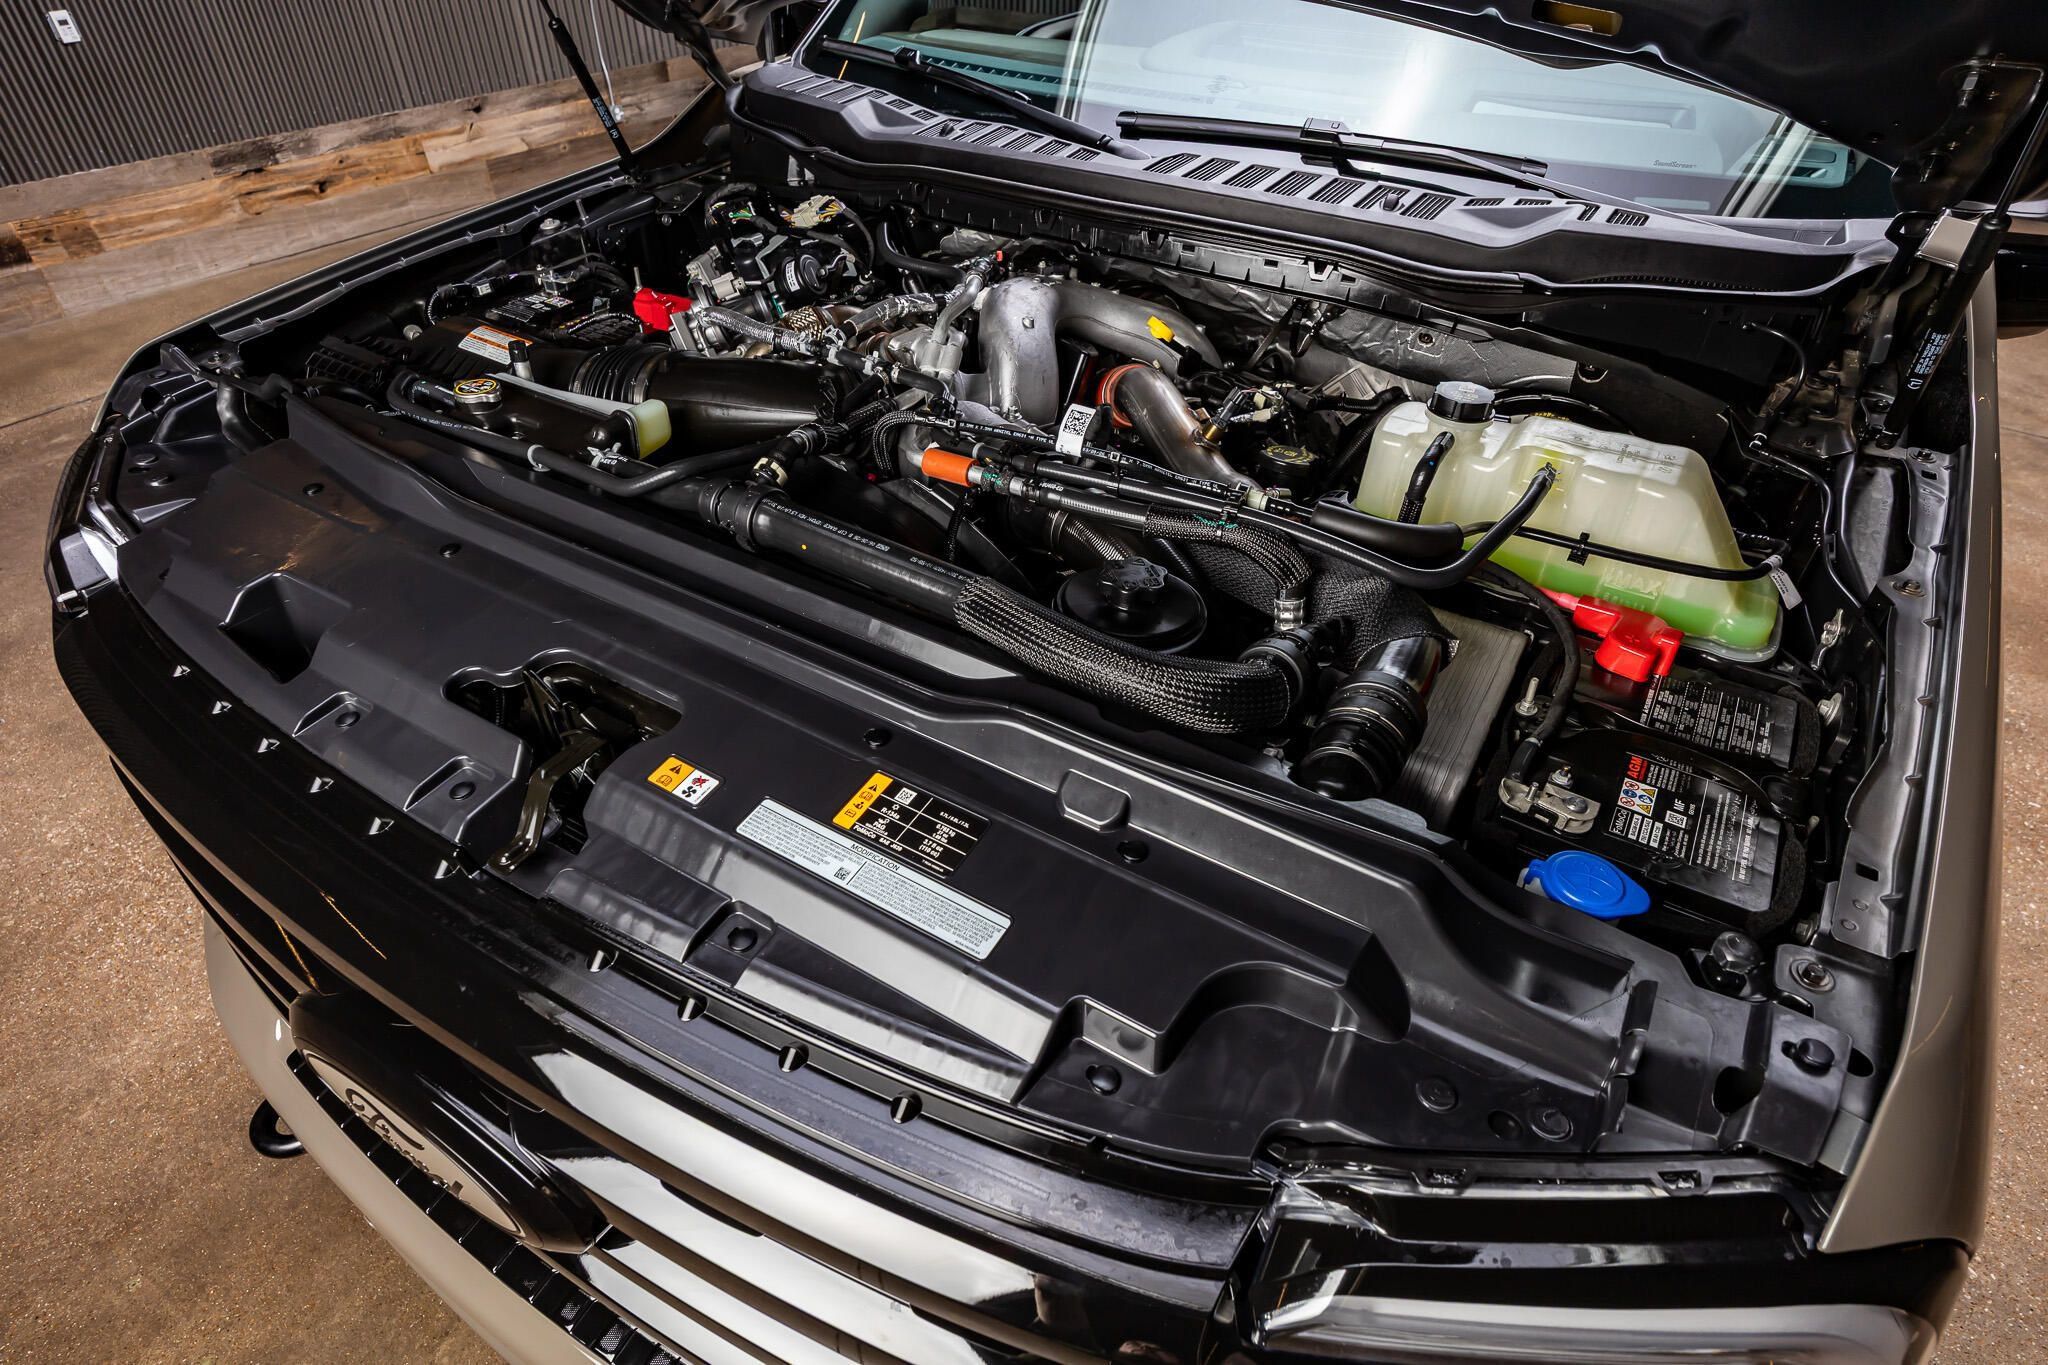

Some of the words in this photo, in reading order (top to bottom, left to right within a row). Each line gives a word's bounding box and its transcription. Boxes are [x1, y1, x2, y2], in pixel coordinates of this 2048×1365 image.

[1626, 756, 1642, 779] AGM
[1673, 798, 1686, 812] MF
[880, 807, 901, 820] R-134a
[872, 821, 887, 830] PAG
[1613, 809, 1627, 834] FoMoCo
[853, 825, 877, 839] FoMoCo
[850, 843, 901, 871] MODIFICATION
